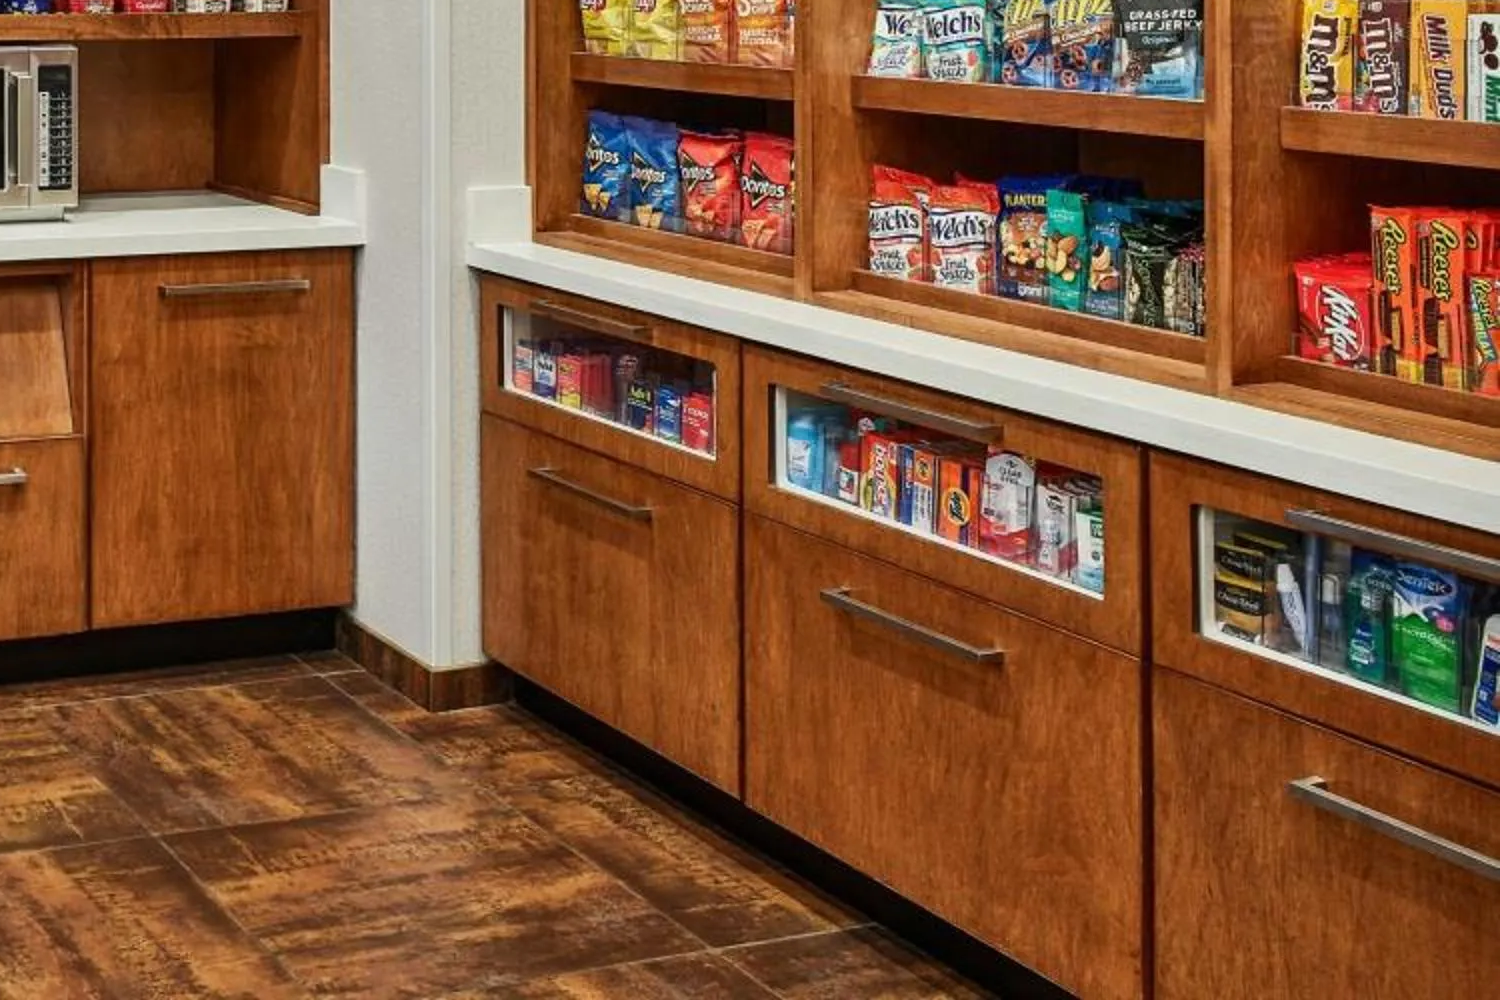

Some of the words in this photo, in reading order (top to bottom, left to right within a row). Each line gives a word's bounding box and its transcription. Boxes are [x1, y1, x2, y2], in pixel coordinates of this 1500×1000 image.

[1129, 8, 1197, 20] GRASS-FED
[1424, 15, 1451, 62] Milk
[1432, 67, 1457, 119] Duds
[586, 149, 620, 165] oritos
[739, 174, 786, 198] Doritos
[1003, 193, 1045, 207] PLANTER
[1381, 217, 1407, 295] Reese's
[1431, 219, 1460, 303] Reese's
